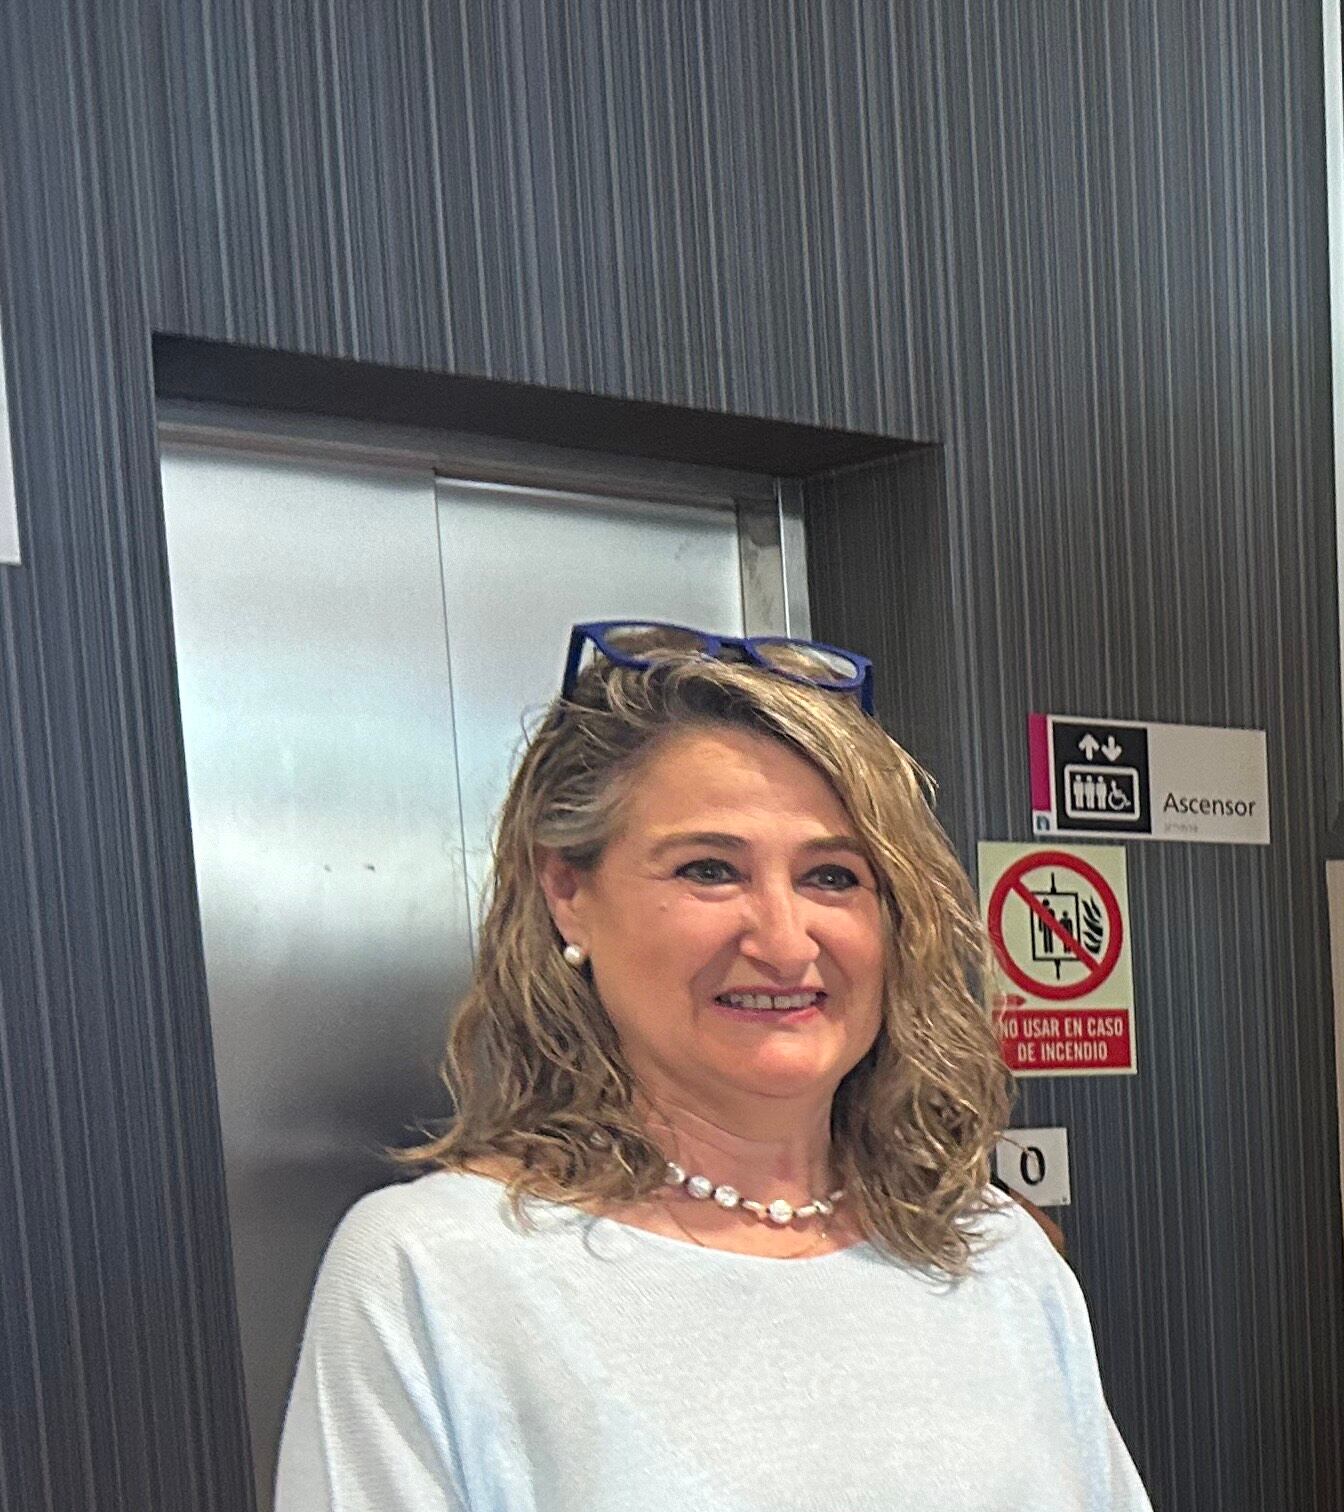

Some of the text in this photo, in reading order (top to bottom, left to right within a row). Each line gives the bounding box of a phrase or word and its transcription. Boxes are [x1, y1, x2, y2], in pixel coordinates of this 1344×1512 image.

[1163, 791, 1256, 817] Ascensor
[1001, 1016, 1123, 1039] NO USAR EN CASO
[1017, 1040, 1109, 1063] DE INCENDIO
